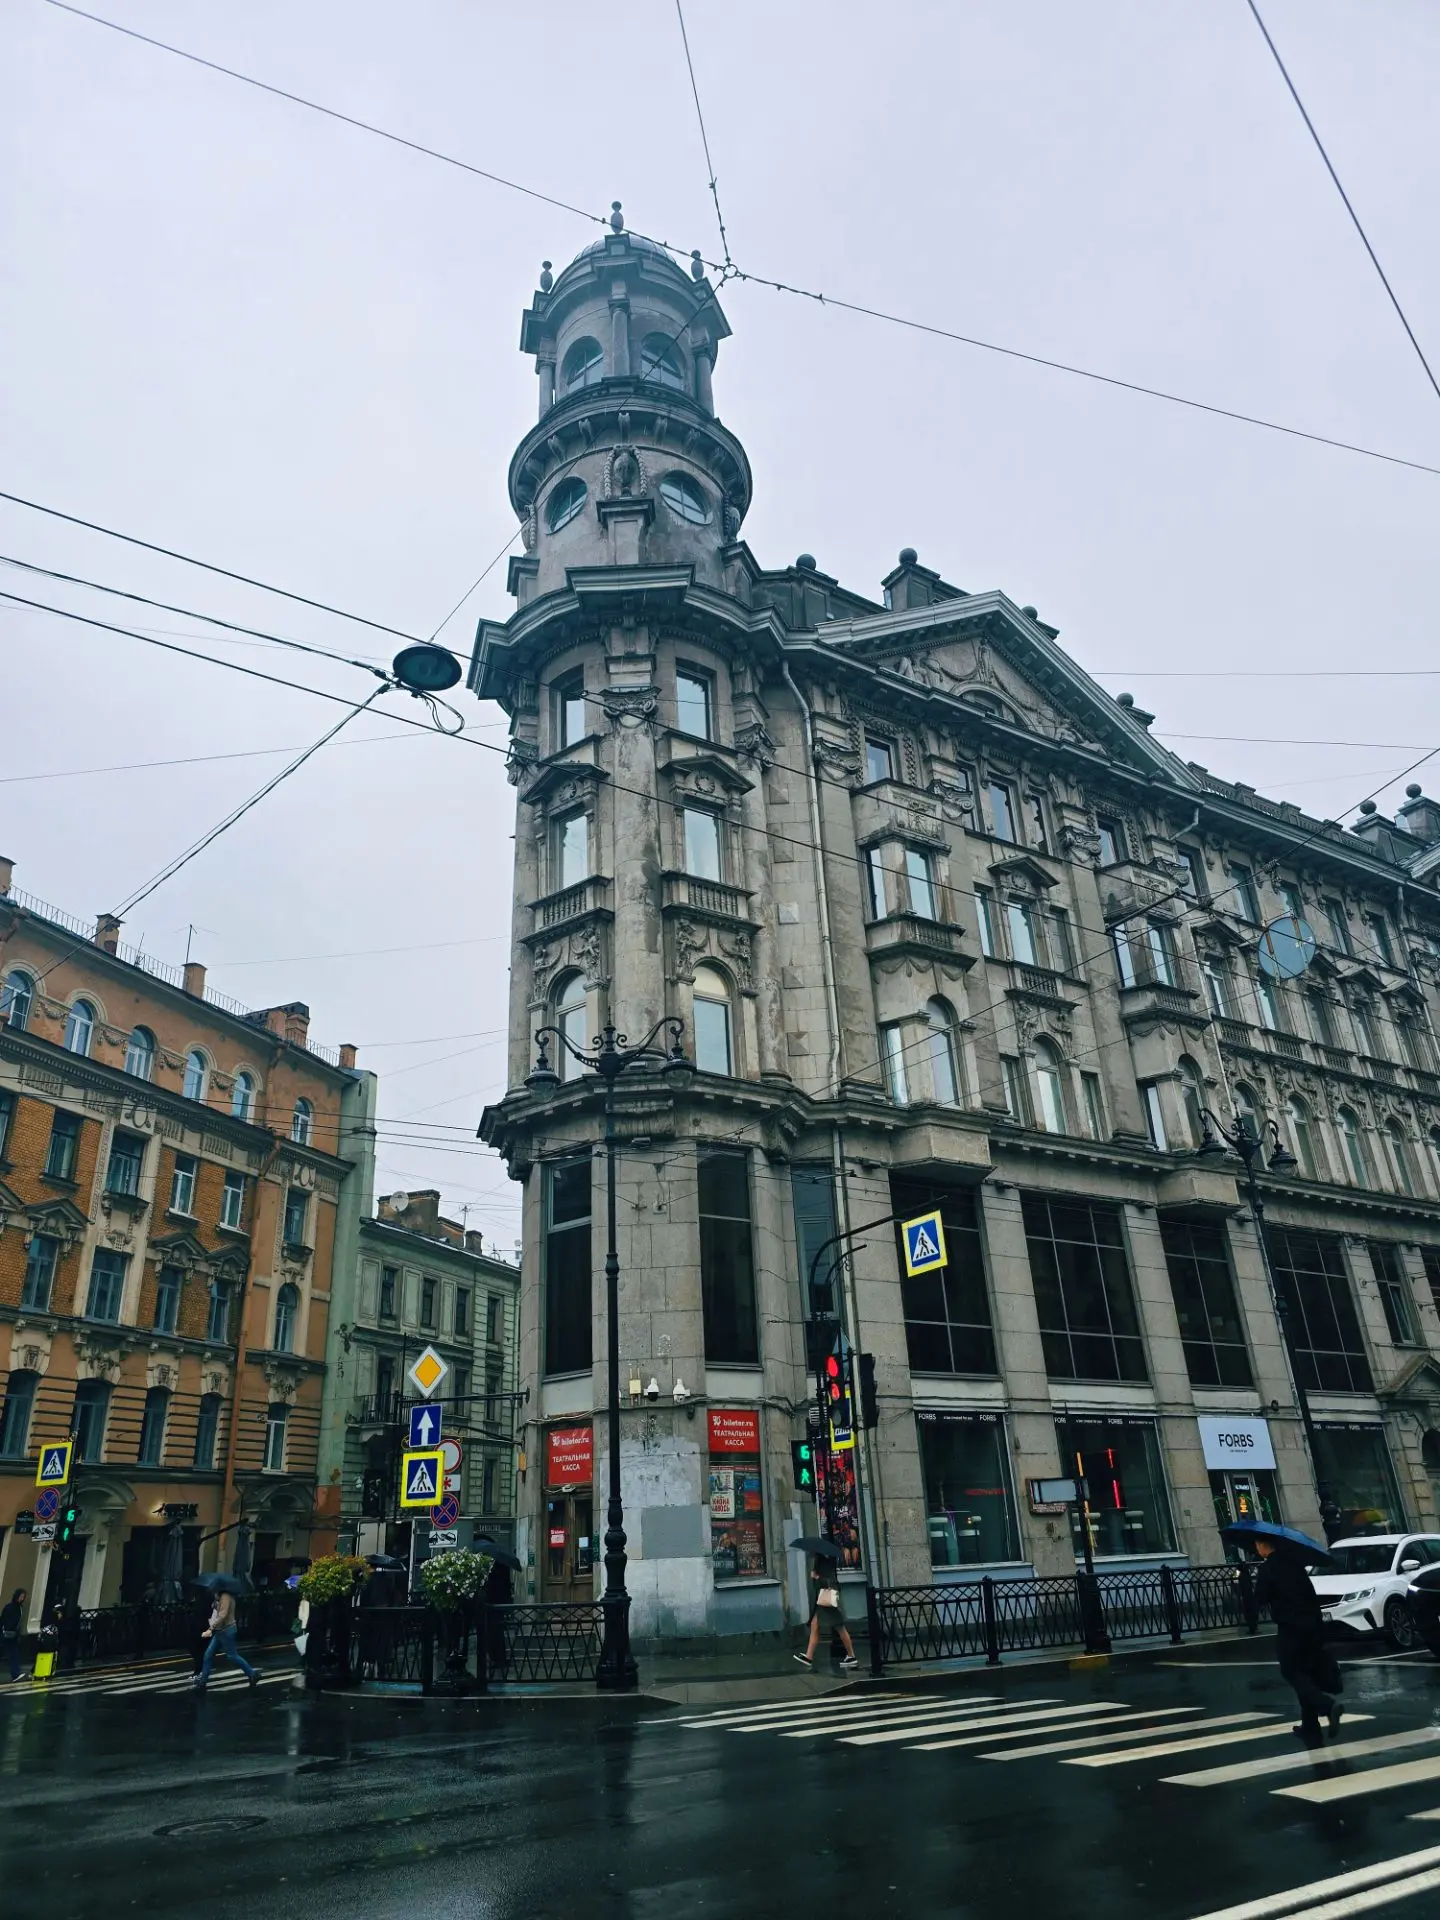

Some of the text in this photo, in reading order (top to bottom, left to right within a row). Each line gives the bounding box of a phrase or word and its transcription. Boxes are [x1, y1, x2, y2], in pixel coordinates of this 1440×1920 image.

[1218, 1433, 1255, 1447] FORBS
[552, 1453, 590, 1463] ТЕАТРАЛЬНАЯ
[562, 1463, 580, 1471] КАССА
